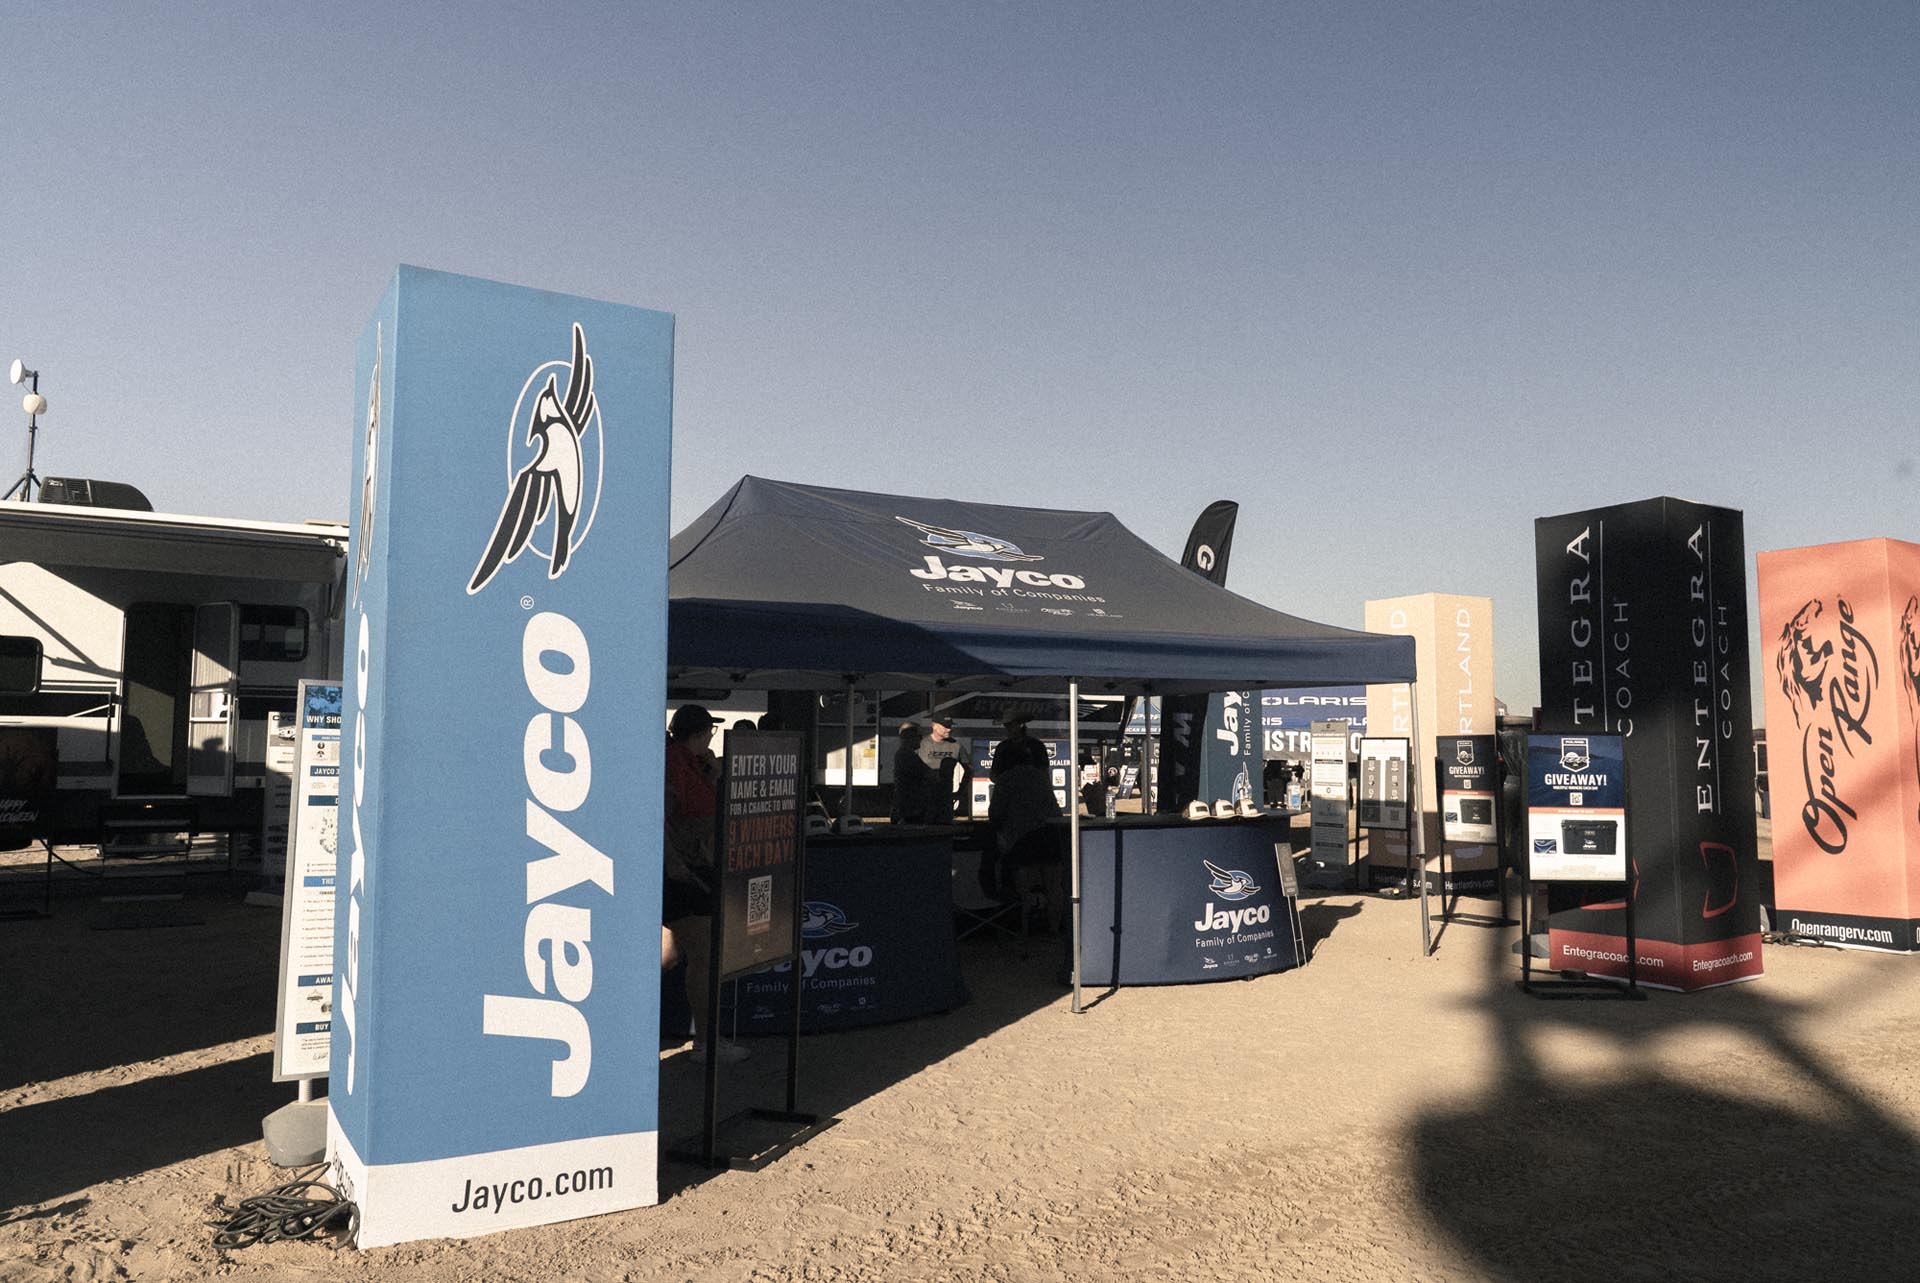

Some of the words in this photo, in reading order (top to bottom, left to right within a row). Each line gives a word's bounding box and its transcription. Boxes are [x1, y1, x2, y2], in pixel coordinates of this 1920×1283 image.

[909, 556, 1086, 590] Jayco
[922, 583, 984, 597] Family
[991, 588, 1007, 597] of
[1013, 588, 1106, 603] Companies
[1567, 525, 1594, 725] TEGRA
[1391, 610, 1409, 733] RTLD
[1614, 602, 1633, 738] COACH
[1688, 524, 1713, 815] ENTEGRA
[1718, 606, 1733, 740] COACH
[1829, 600, 1879, 759] Range
[306, 715, 324, 723] WHY
[326, 715, 341, 723] SHO
[1243, 702, 1250, 715] of
[1243, 718, 1253, 756] Family
[314, 767, 334, 775] JAYCO
[731, 754, 766, 777] ENTER
[769, 754, 797, 775] YOUR
[1449, 766, 1485, 775] GIVEAWAY!
[730, 780, 758, 800] NAME
[759, 780, 767, 798] &
[769, 778, 796, 797] EMAIL
[1544, 773, 1607, 786] GIVEAWAY!
[1802, 723, 1857, 855] Open
[729, 803, 742, 816] FOR
[742, 802, 748, 815] A
[748, 801, 772, 814] CHANCE
[772, 800, 781, 812] TO
[781, 799, 796, 811] WIN!
[739, 815, 796, 842] WINNERS
[341, 613, 370, 1094] Jayco
[483, 612, 614, 1098] Jayco
[728, 844, 761, 873] EACH
[765, 838, 795, 866] DAY!
[1194, 902, 1270, 933] Jayco
[1792, 918, 1893, 944] Openrangerv.com
[1196, 937, 1224, 948] Family
[1226, 934, 1236, 944] of
[1238, 930, 1274, 942] Companies
[1563, 945, 1664, 968] Entegracoac.com
[1693, 952, 1753, 972] Entegracoach.com
[747, 982, 789, 995] Family
[811, 976, 876, 990] Companies
[452, 1166, 614, 1214] Jayco.com
